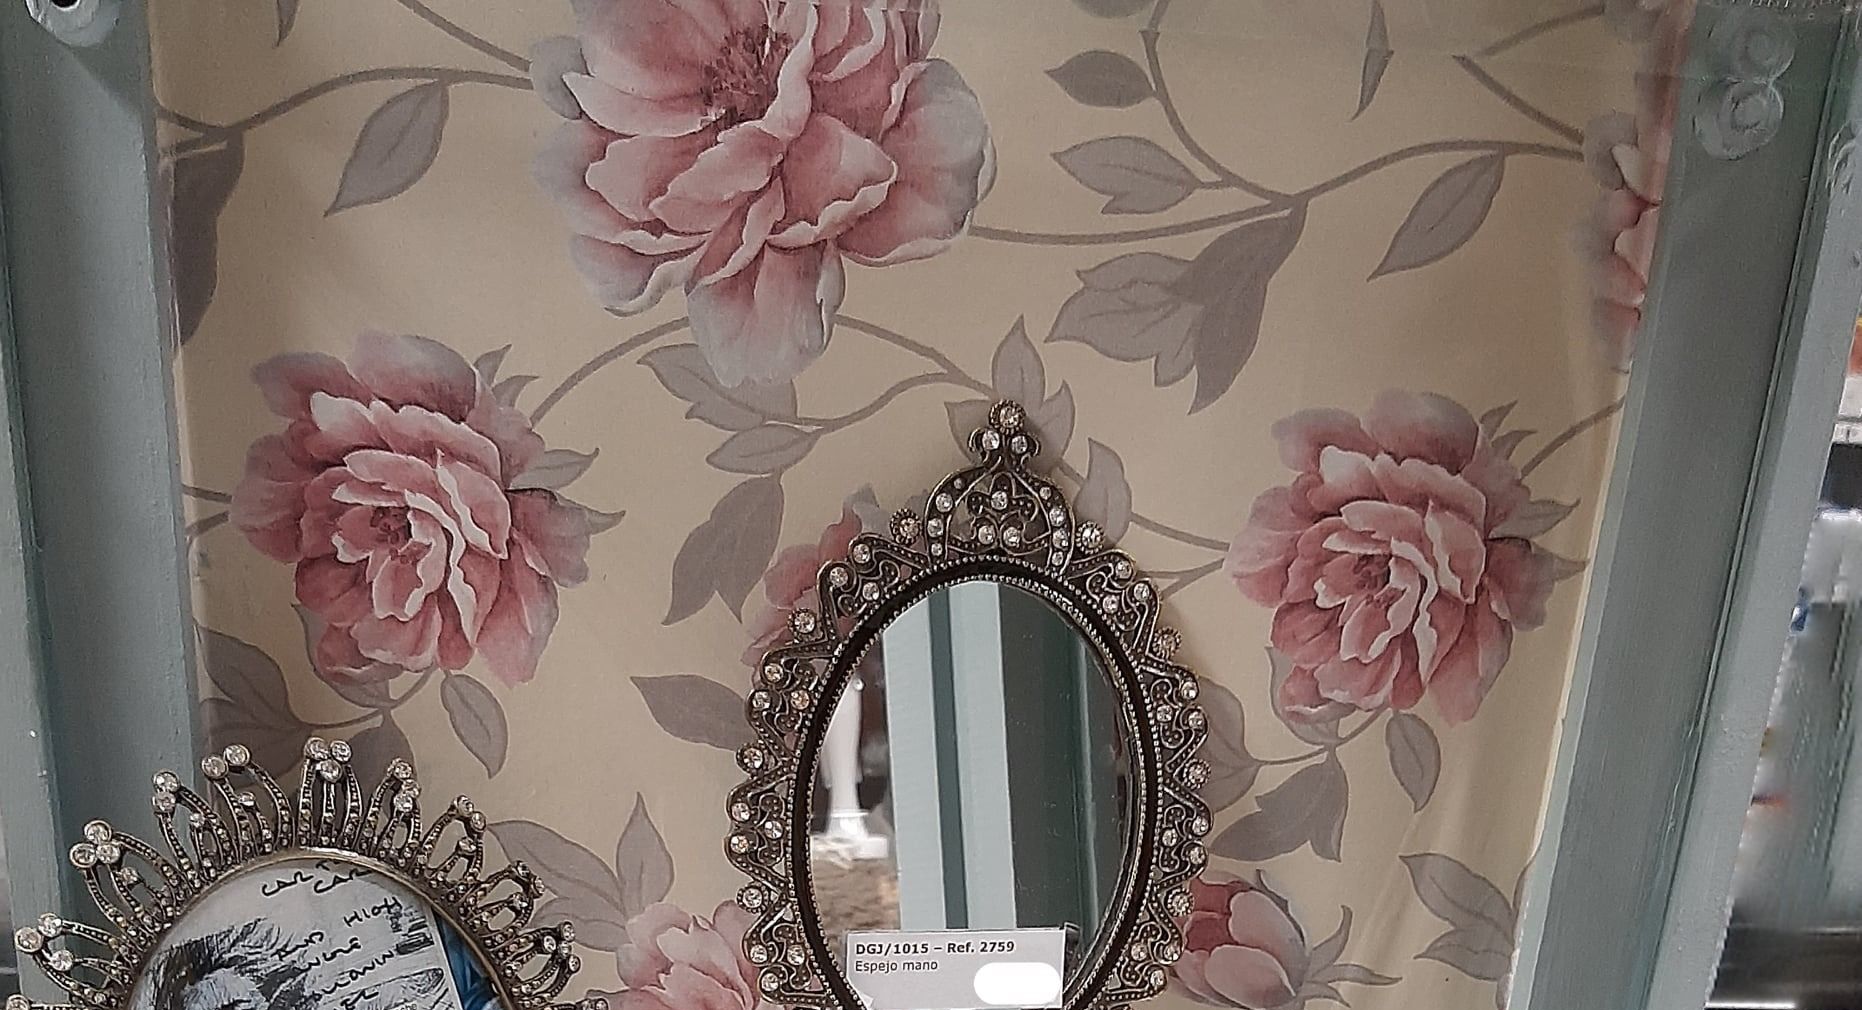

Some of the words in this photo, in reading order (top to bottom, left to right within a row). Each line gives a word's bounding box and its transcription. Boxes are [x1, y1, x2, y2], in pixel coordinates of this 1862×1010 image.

[855, 943, 929, 956] DGJ/1015
[947, 942, 975, 953] Ref.
[980, 941, 1015, 953] 2759
[855, 960, 898, 974] Espejo
[903, 961, 938, 971] mano
